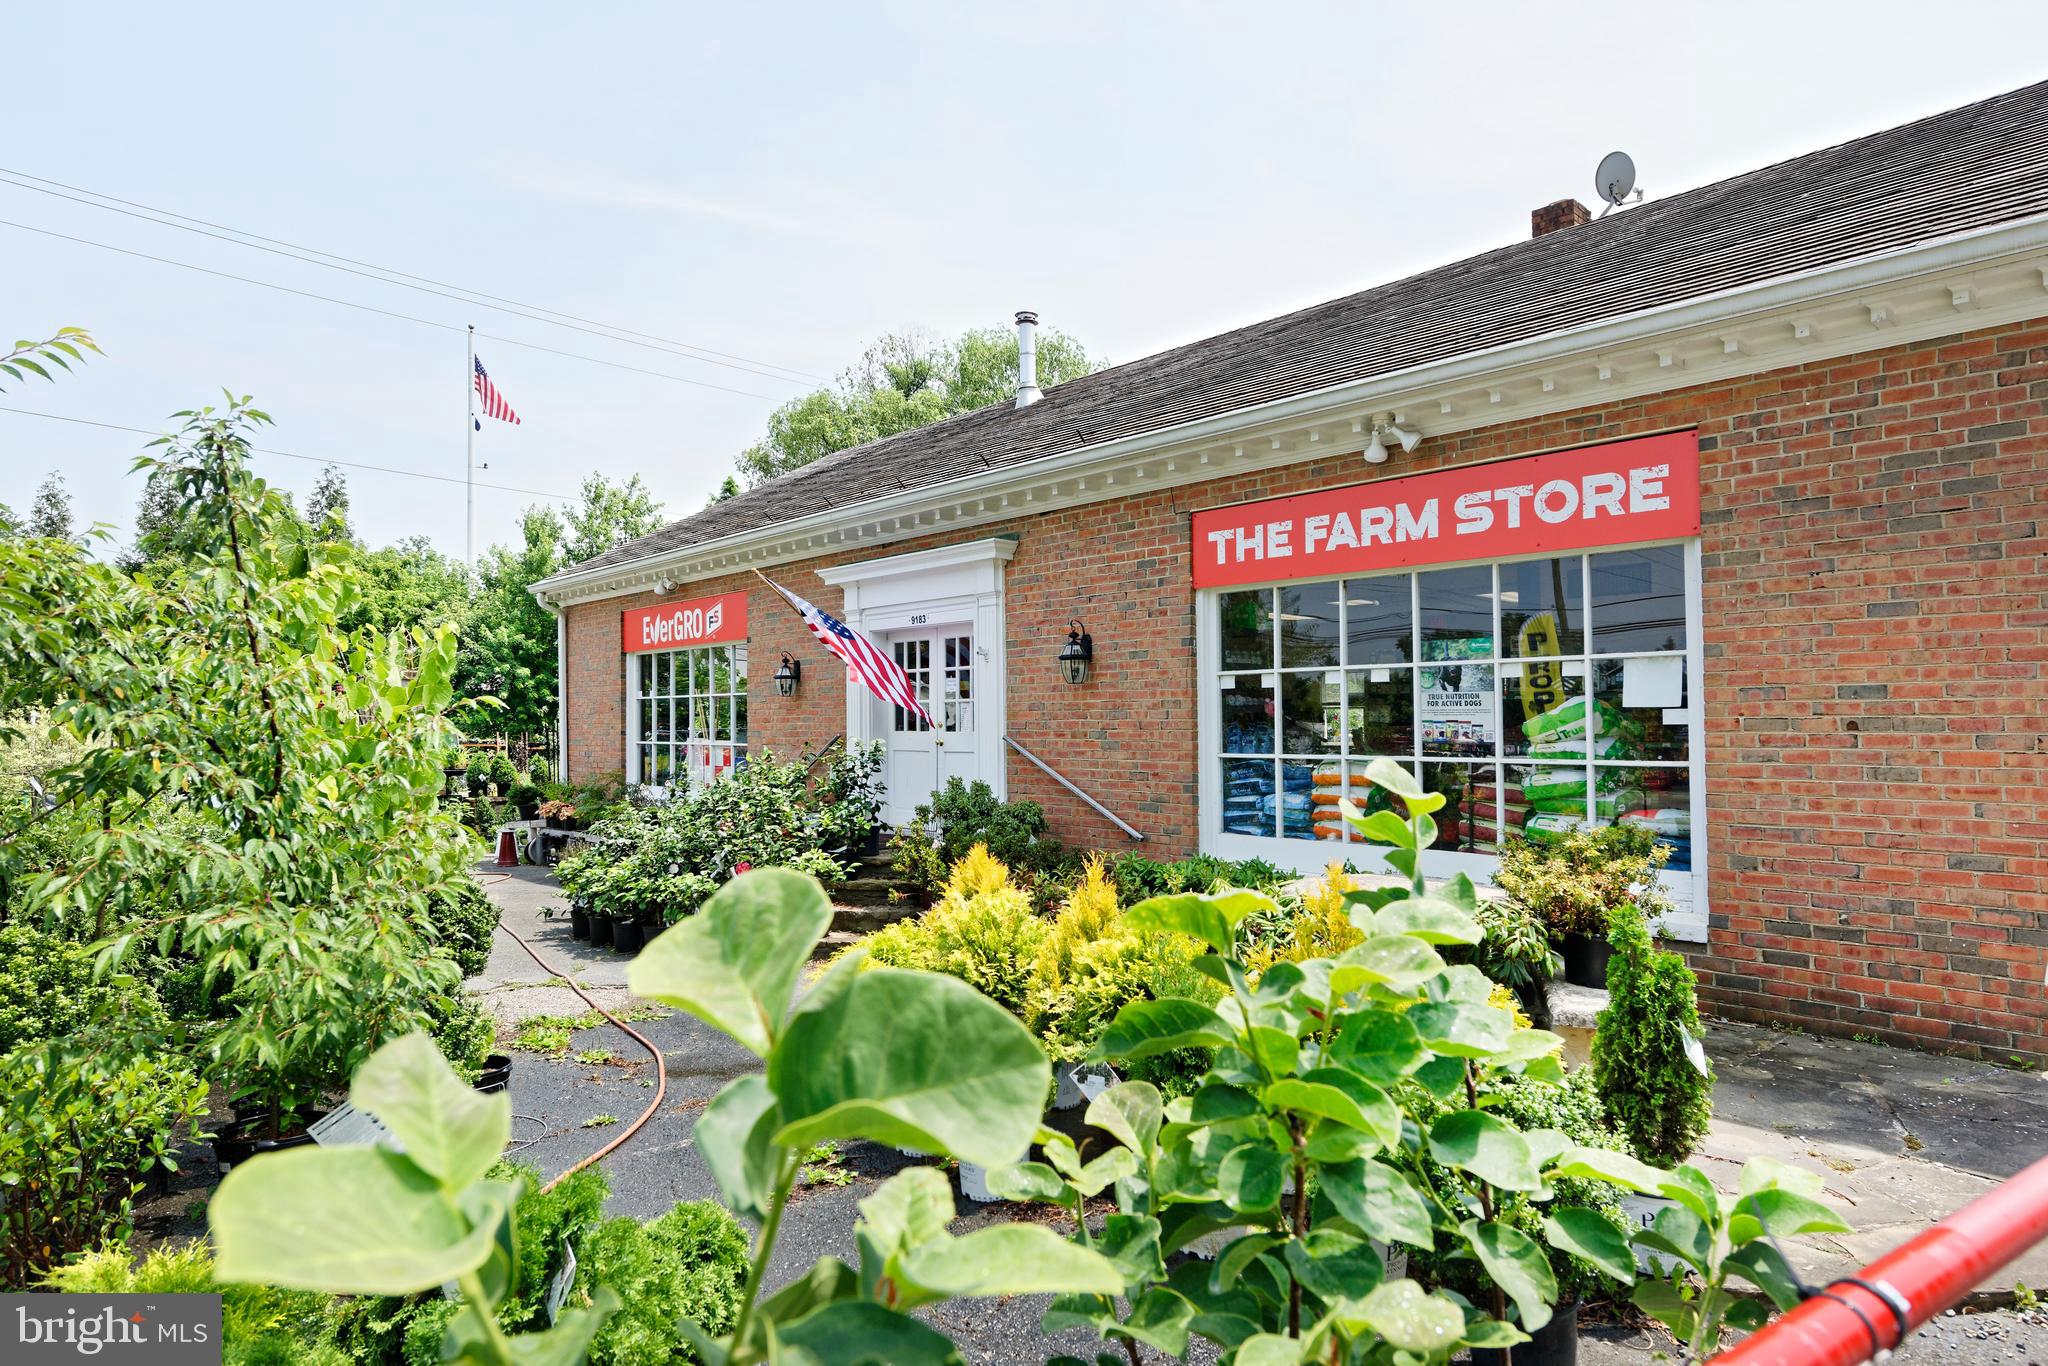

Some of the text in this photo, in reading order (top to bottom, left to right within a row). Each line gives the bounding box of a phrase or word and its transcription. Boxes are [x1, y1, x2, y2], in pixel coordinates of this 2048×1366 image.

[1208, 464, 1670, 565] THE FARM STORE
[708, 610, 719, 629] FS
[911, 614, 927, 624] 9183
[1445, 692, 1480, 700] NUTRITION
